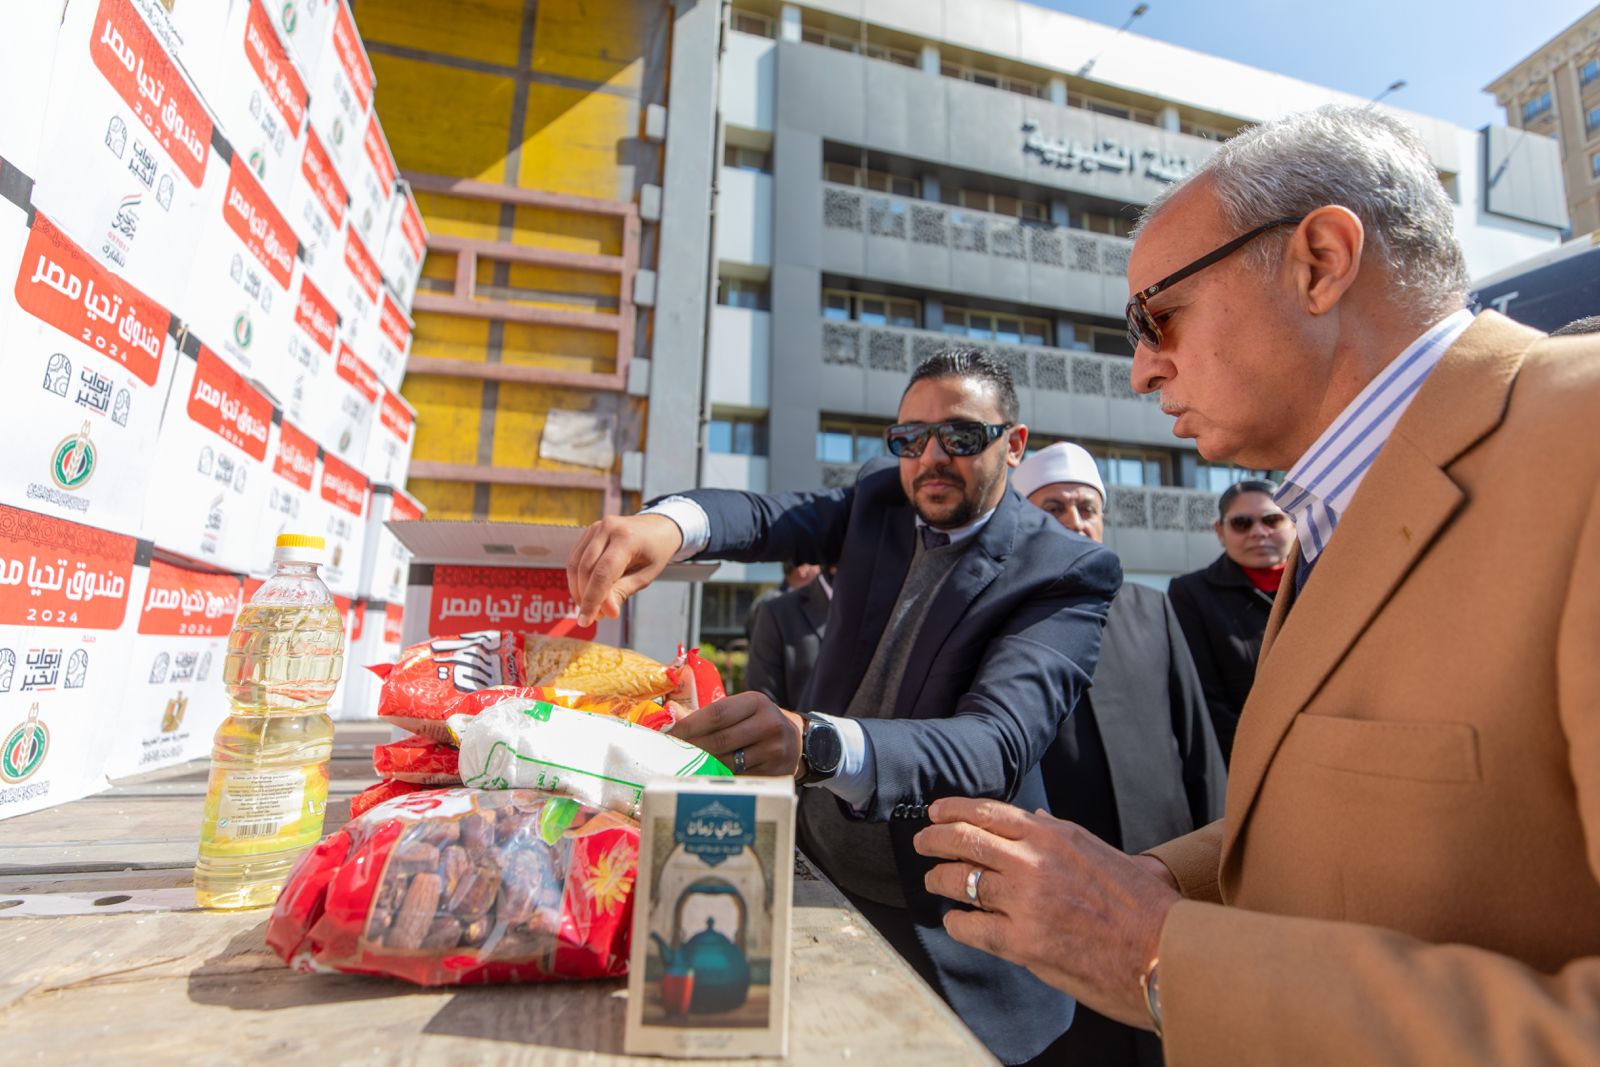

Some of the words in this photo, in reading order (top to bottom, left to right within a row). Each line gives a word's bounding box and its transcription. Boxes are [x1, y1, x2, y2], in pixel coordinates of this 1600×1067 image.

[101, 19, 136, 72] مصر
[137, 57, 164, 107] تحيا
[134, 101, 171, 149] 2024
[162, 97, 204, 164] صندوق
[31, 255, 82, 300] مصر
[84, 279, 122, 324] تحيا
[82, 328, 127, 362] 2024
[118, 306, 161, 359] صندوق
[75, 389, 109, 413] الخير
[80, 371, 114, 397] أبواب
[27, 556, 68, 596] تحيا
[66, 561, 124, 601] صندوق
[27, 608, 78, 623] 2024
[439, 596, 482, 621] مصر
[485, 593, 522, 623] تحيا
[523, 594, 580, 624] ندوق
[26, 649, 63, 669] أبواب
[20, 669, 59, 691] الخير
